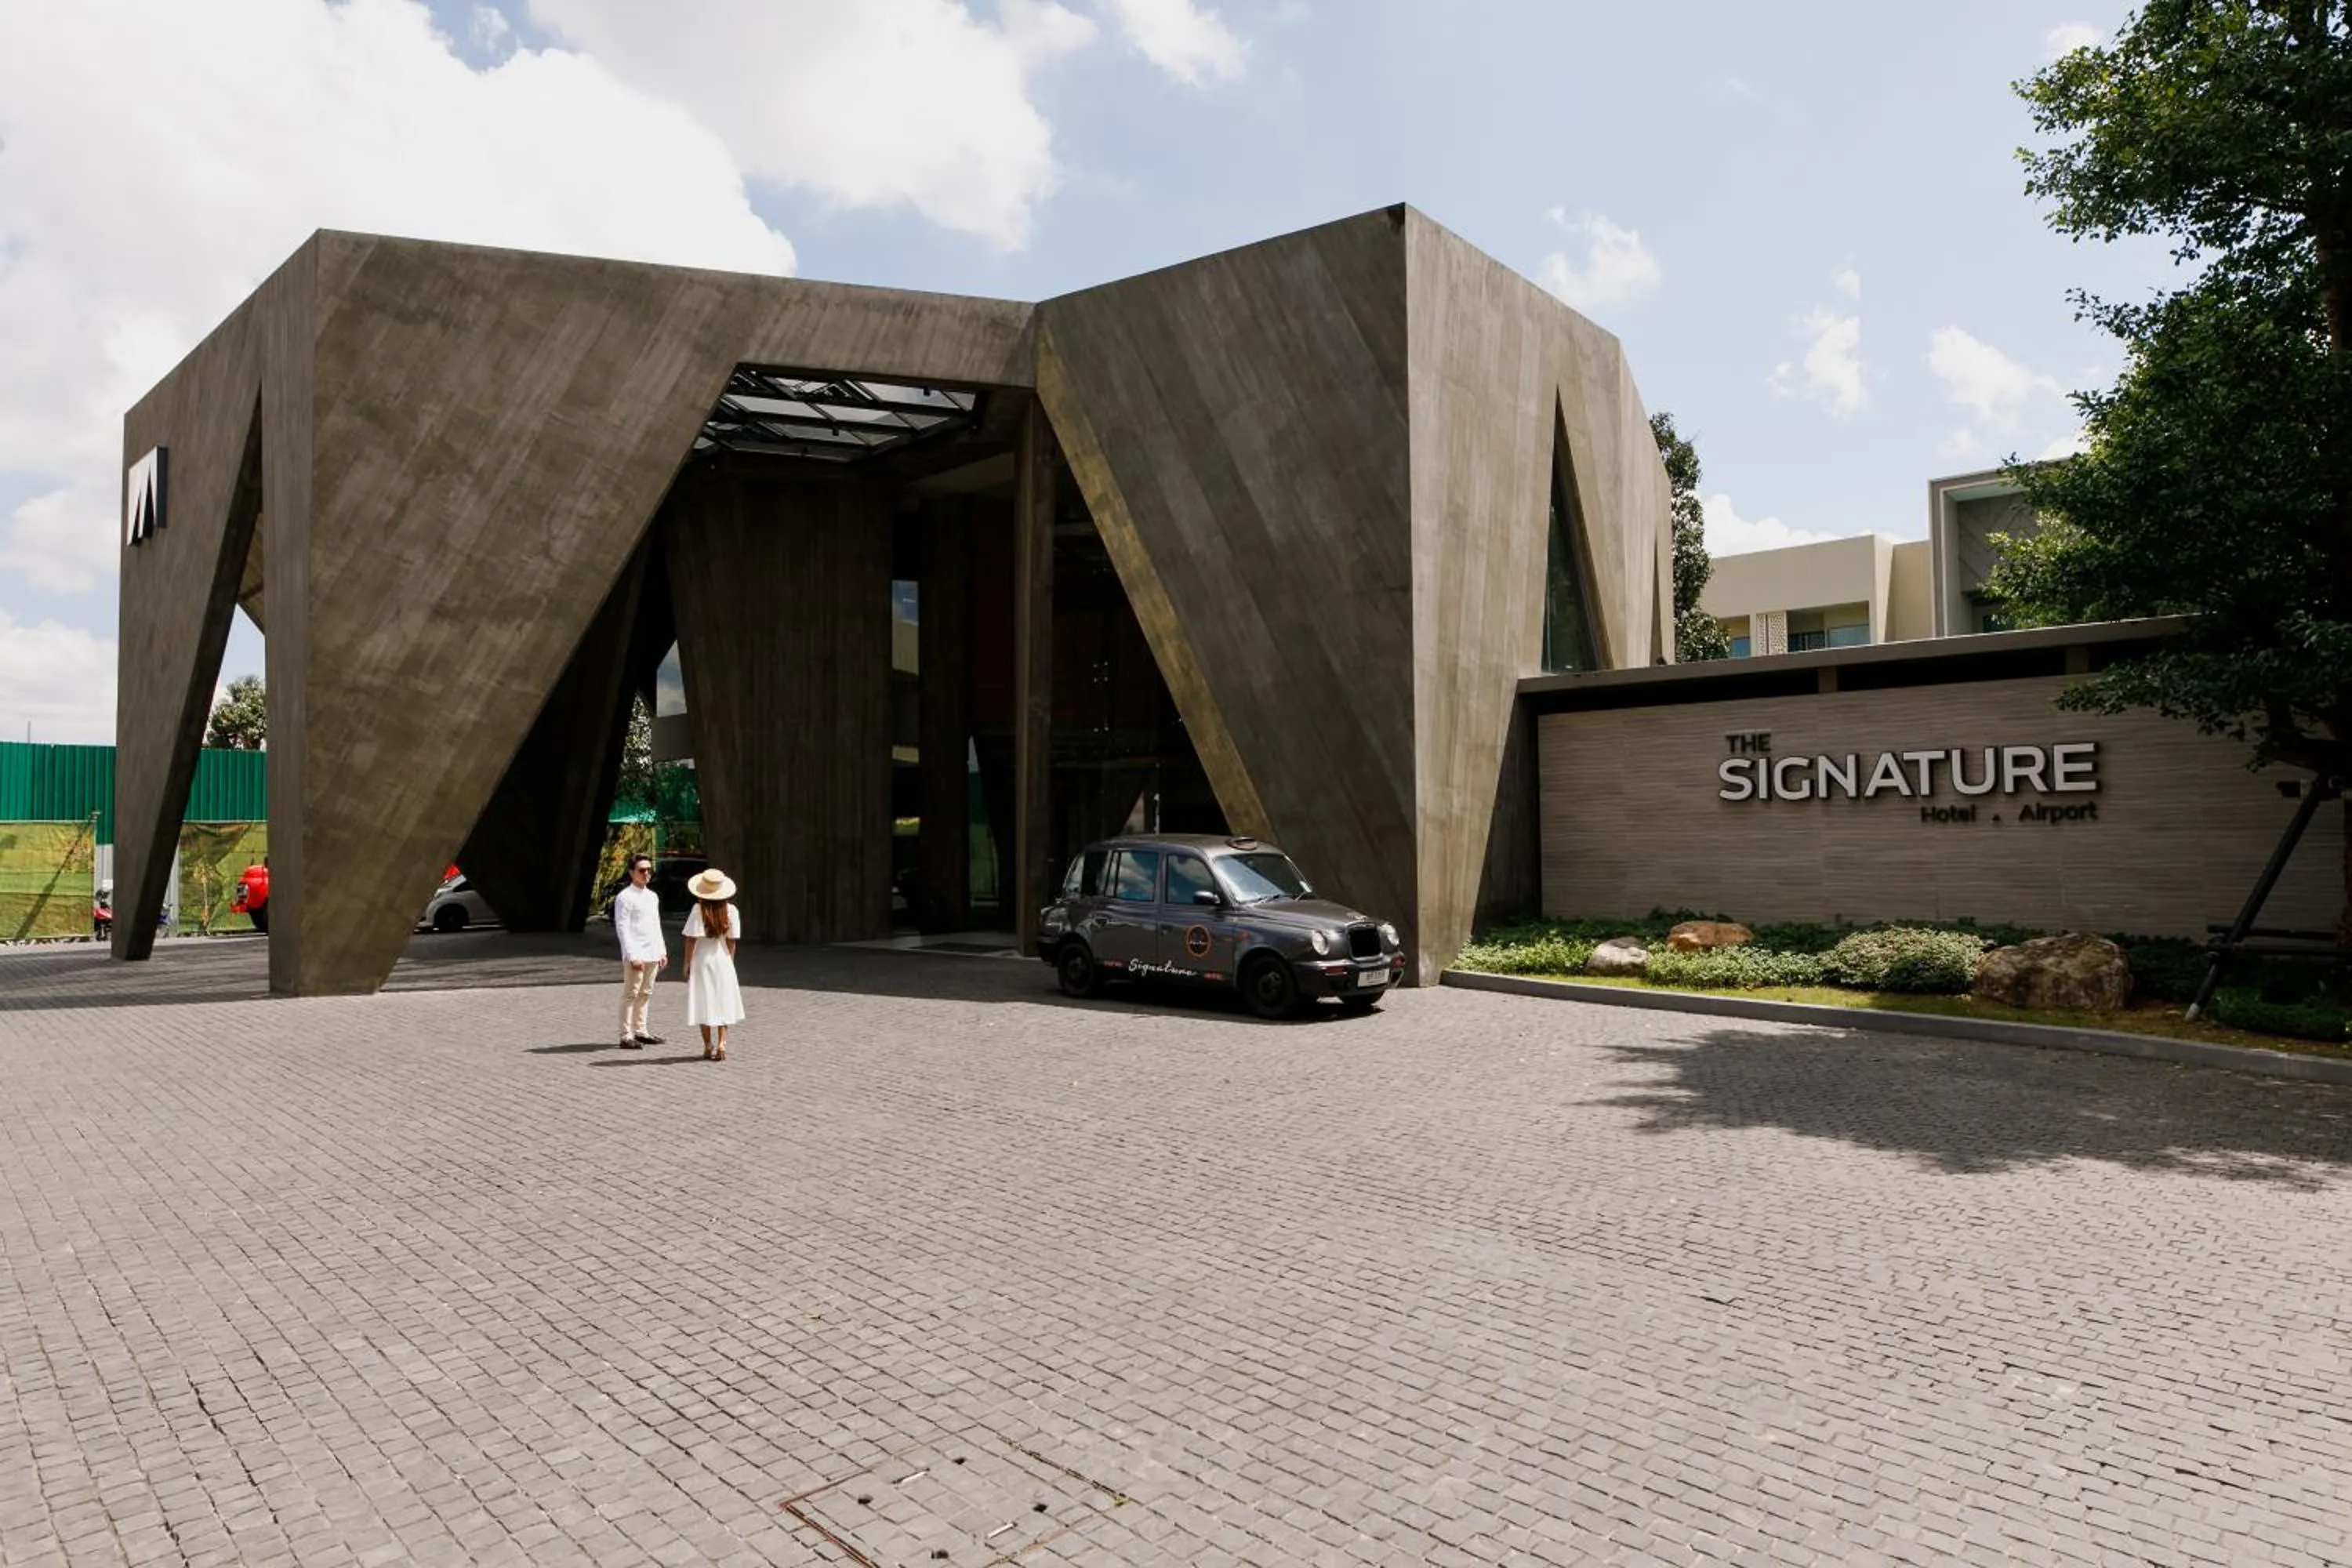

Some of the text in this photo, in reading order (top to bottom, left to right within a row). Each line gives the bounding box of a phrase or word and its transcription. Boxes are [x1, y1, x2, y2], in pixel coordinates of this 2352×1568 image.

[1725, 731, 1772, 753] THE
[1718, 742, 2100, 801] SIGNATURE
[1920, 800, 2100, 825] Hotel Airport
[1128, 958, 1198, 977] Signature
